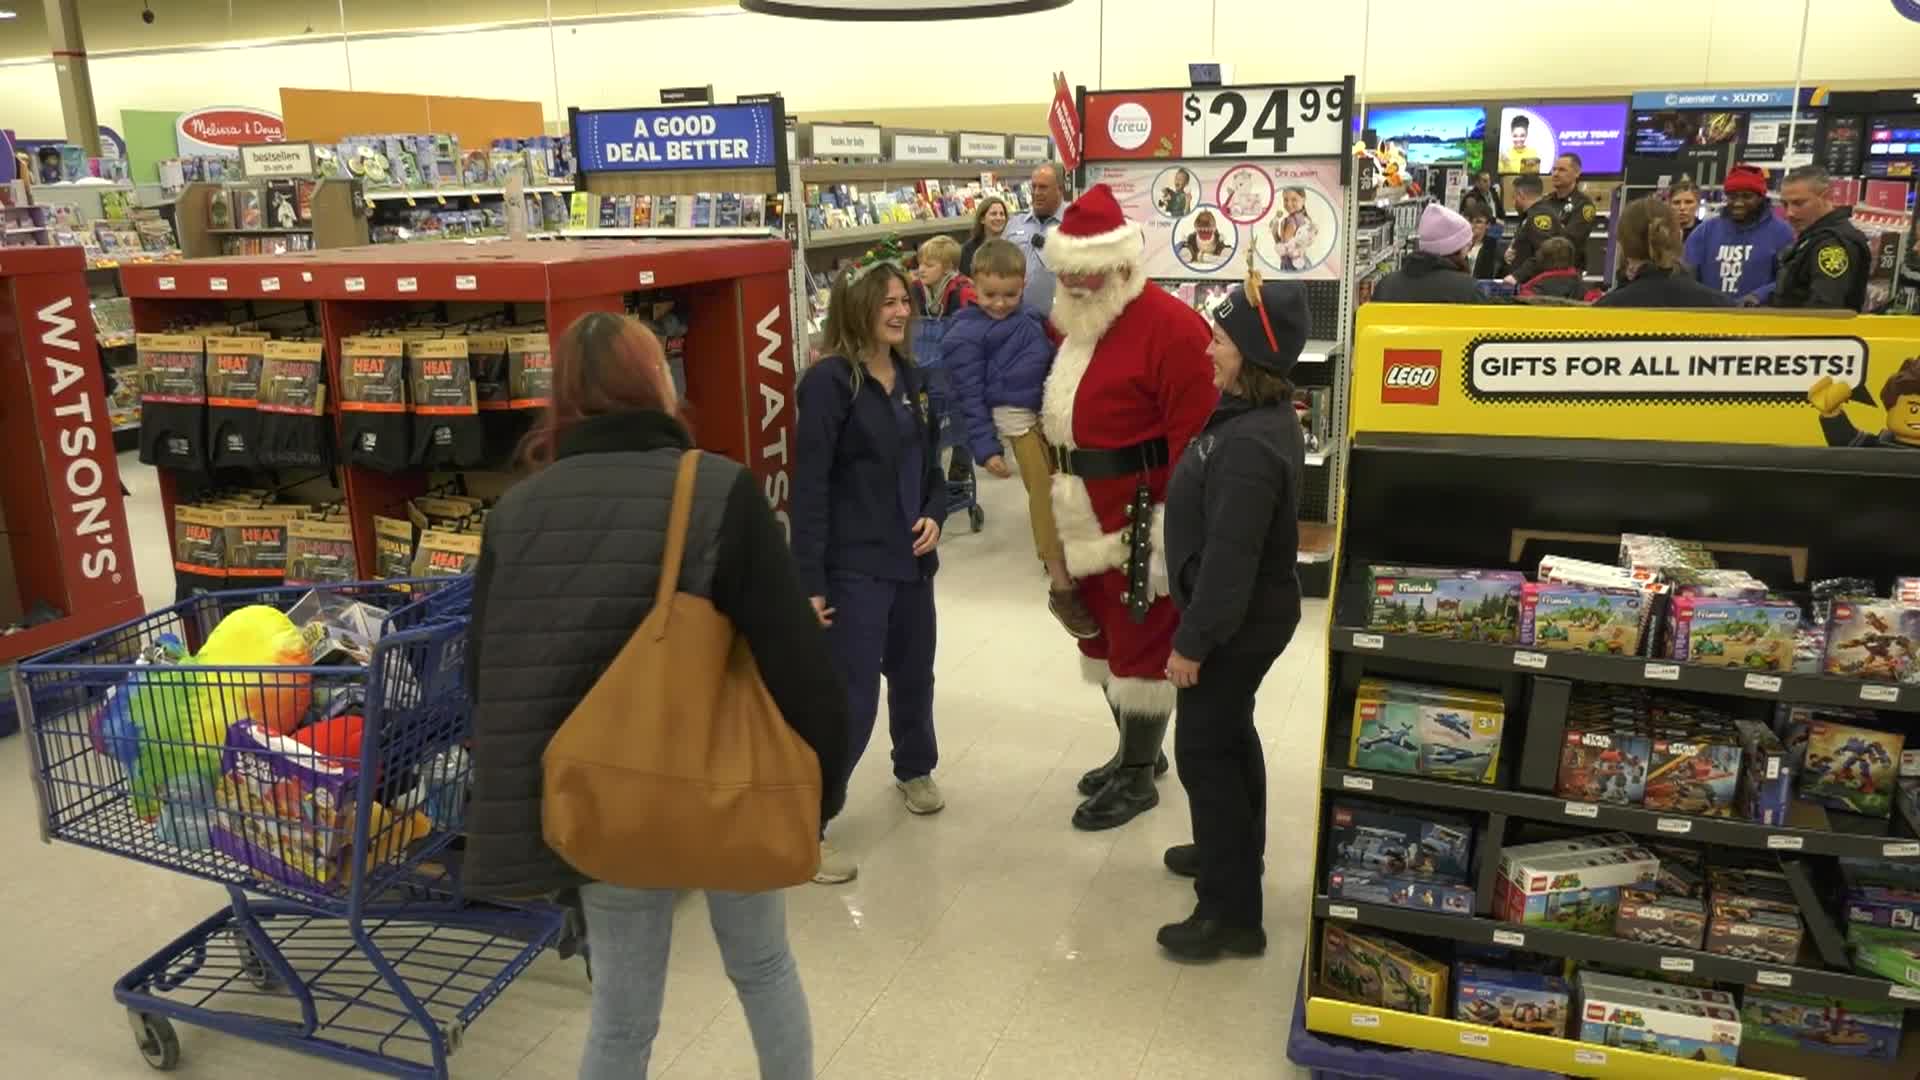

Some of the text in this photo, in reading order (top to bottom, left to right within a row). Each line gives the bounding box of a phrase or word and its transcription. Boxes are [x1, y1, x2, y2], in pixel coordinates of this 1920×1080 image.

[191, 119, 242, 138] Melissa
[253, 121, 287, 142] Doug
[633, 115, 717, 138] A GOOD
[1559, 130, 1620, 140] APPLY TODAY
[252, 152, 301, 163] bestsellers
[606, 139, 749, 163] DEAL BETTER
[1715, 245, 1753, 261] JUST
[1719, 262, 1743, 277] DO
[1720, 277, 1738, 293] IT.
[217, 356, 249, 369] HEAT
[353, 358, 385, 373] HEAT
[423, 359, 453, 375] HEAT
[1481, 354, 1855, 377] GIFTS FOR ALL INTERESTS!
[1385, 364, 1438, 388] LEGO
[38, 296, 118, 580] WATSON'S
[185, 526, 212, 540] HEAT
[241, 528, 281, 542] HEAT
[429, 551, 465, 568] HEAT
